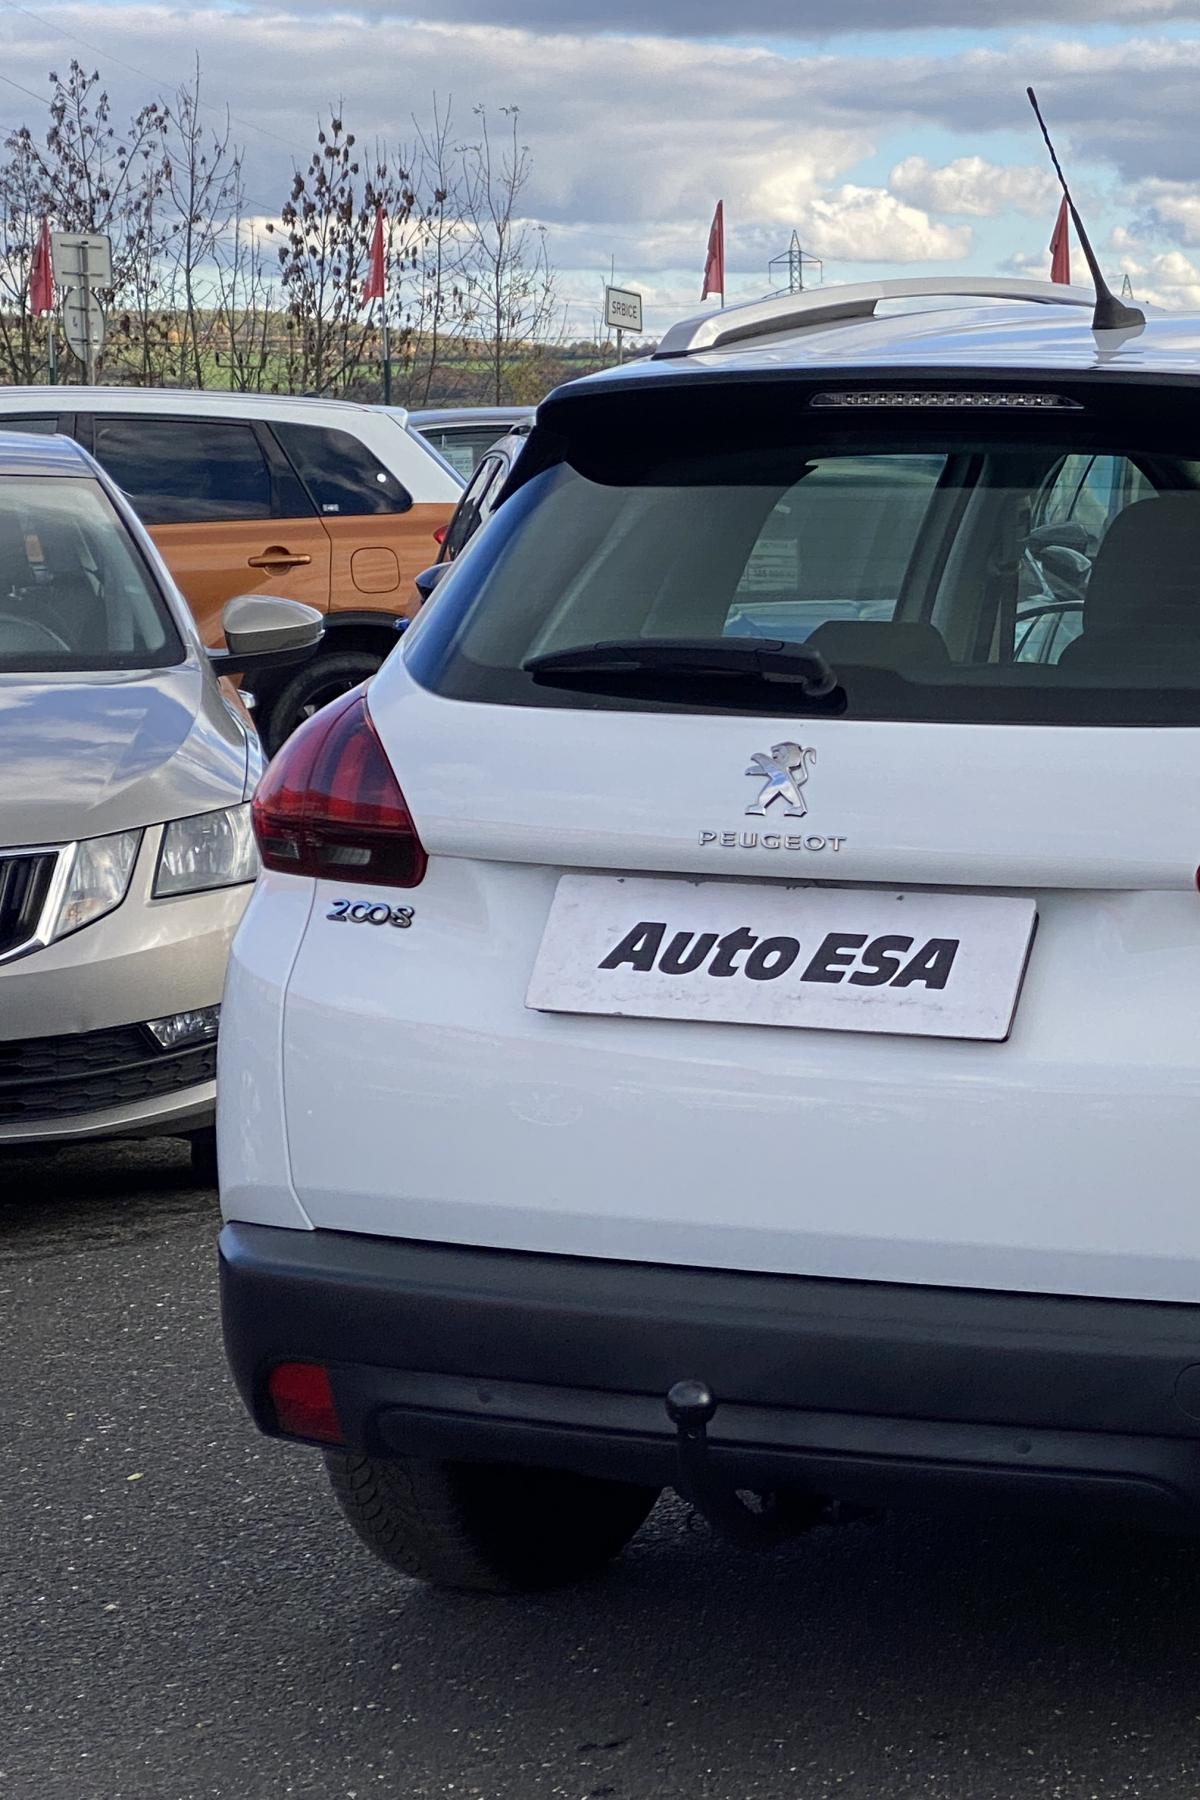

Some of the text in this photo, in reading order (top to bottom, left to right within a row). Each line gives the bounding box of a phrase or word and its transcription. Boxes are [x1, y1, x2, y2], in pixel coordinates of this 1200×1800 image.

[611, 300, 638, 319] SRBICE
[698, 829, 847, 852] PEUGEOT
[326, 897, 416, 930] 2008
[599, 921, 960, 991] Auto ESA
